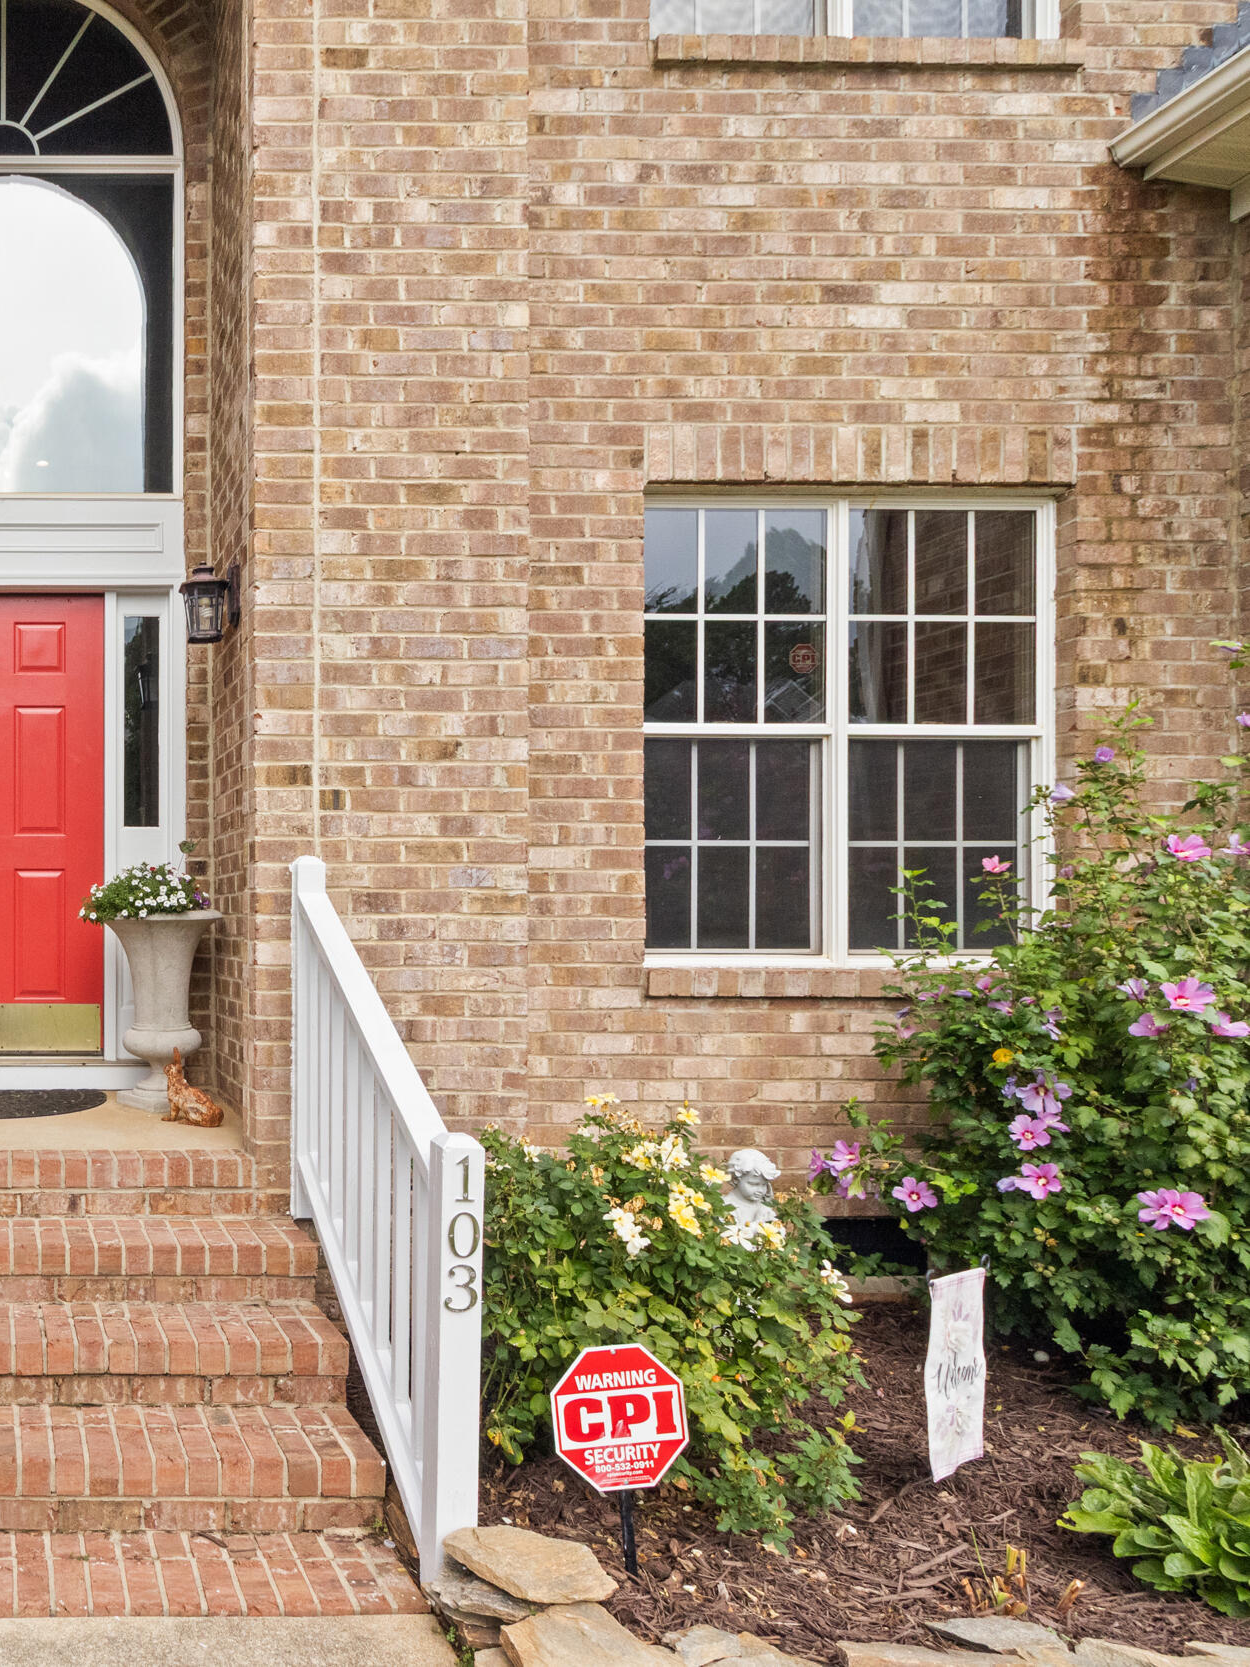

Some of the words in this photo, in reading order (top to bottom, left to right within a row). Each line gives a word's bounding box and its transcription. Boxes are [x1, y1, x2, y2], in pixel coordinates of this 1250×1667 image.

[791, 654, 816, 663] CPI
[444, 1155, 480, 1313] 103
[574, 1369, 656, 1391] WARNING
[563, 1391, 677, 1443] CPI
[584, 1443, 661, 1466] SECURITY
[595, 1460, 654, 1473] 800-532-0911
